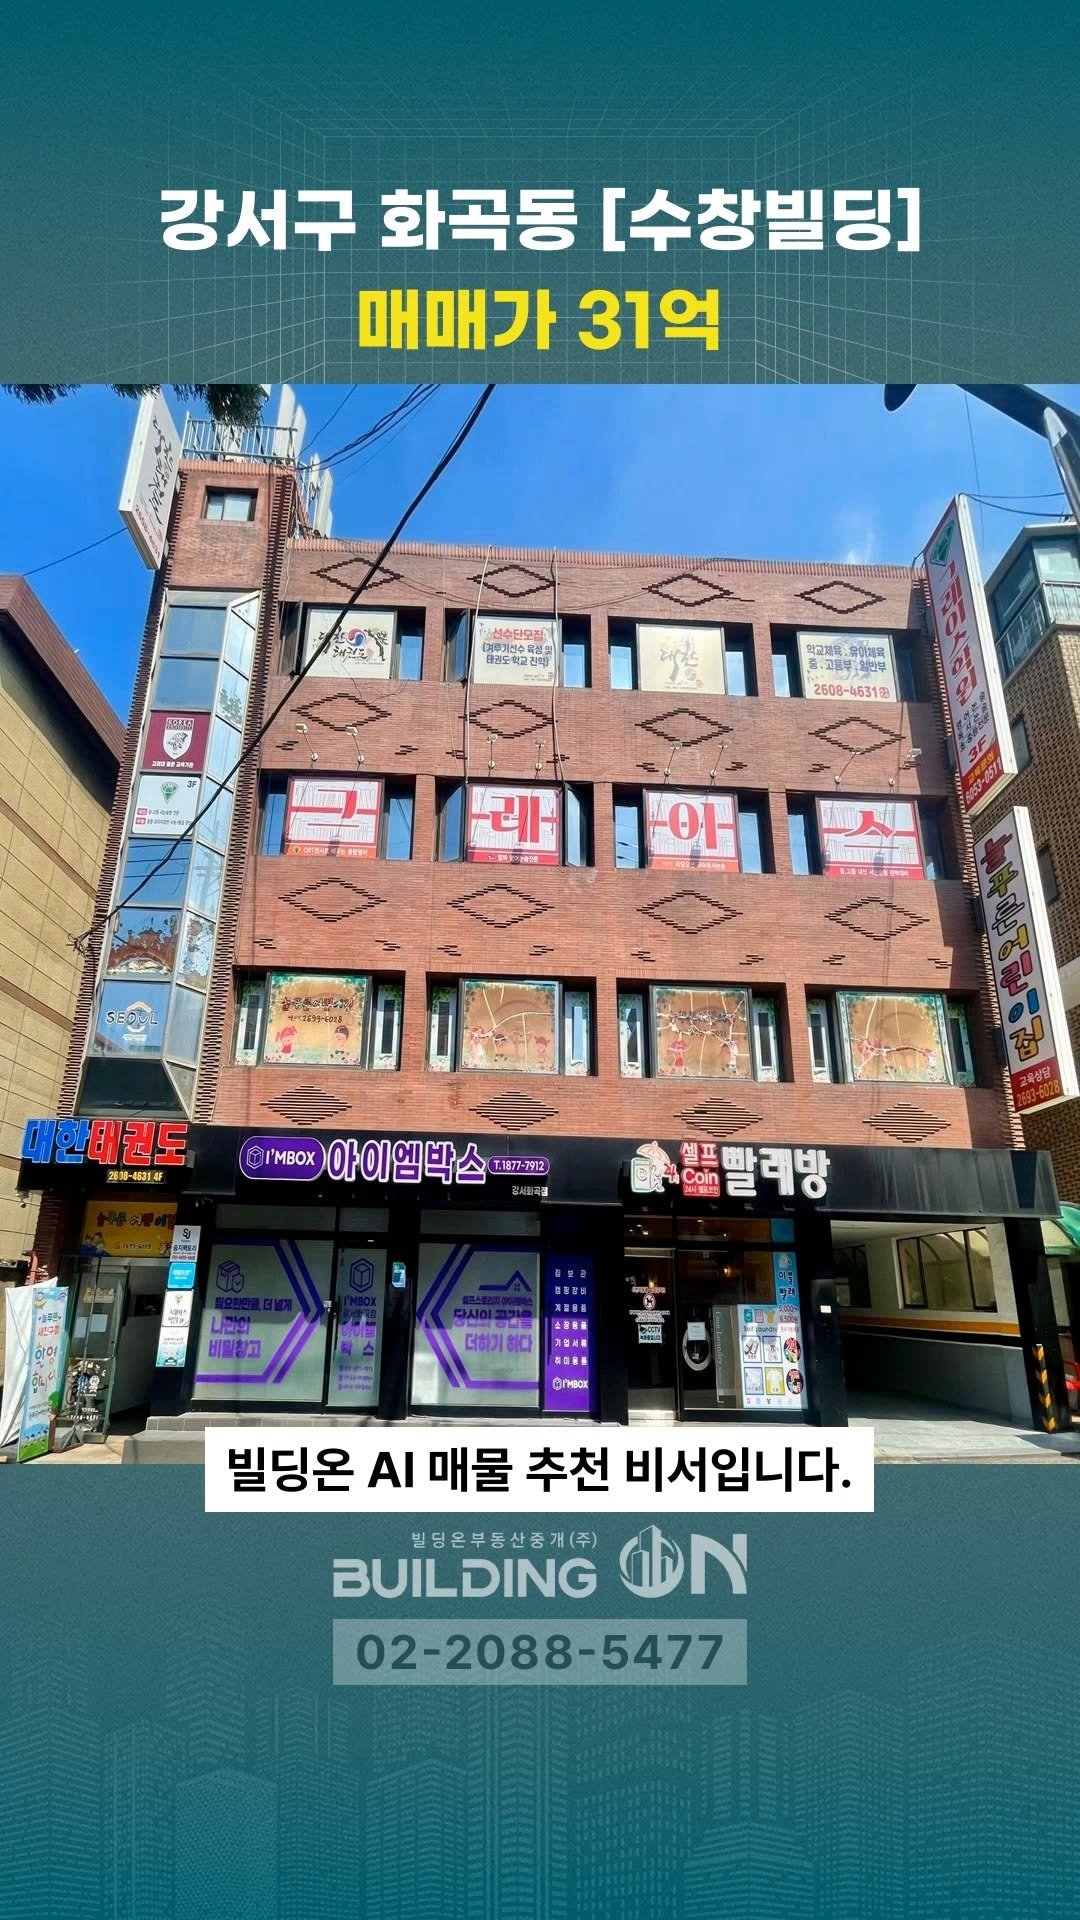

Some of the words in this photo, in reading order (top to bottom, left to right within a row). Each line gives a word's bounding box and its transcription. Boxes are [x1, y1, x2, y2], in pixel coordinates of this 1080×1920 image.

[493, 627, 544, 641] 선수단모집
[935, 559, 978, 706] 그레이스학원
[486, 654, 510, 665] 태권도
[512, 655, 528, 666] 학교
[814, 683, 878, 698] 2608-4631
[968, 734, 987, 764] 3F
[187, 780, 198, 788] 3F
[980, 831, 1045, 1063] 늘푸른어린이집
[302, 1015, 343, 1023] 2693-6028
[1019, 1065, 1051, 1088] 교육상담
[1016, 1079, 1060, 1107] 2693-6028
[265, 1148, 316, 1166] I'MBOX
[327, 1138, 487, 1185] 아이엠박스
[493, 1159, 545, 1172] T.1877-7912
[680, 1141, 719, 1168] 셀프
[108, 1170, 151, 1181] 2608-4631
[152, 1171, 163, 1181] 4F
[682, 1167, 719, 1185] Coin
[720, 1145, 831, 1199] 빨래방
[453, 1308, 493, 1329] 당신의
[495, 1309, 533, 1330] 공간을
[208, 1340, 262, 1359] 비밀창고
[465, 1333, 504, 1353] 더하기
[506, 1334, 533, 1353] 하다
